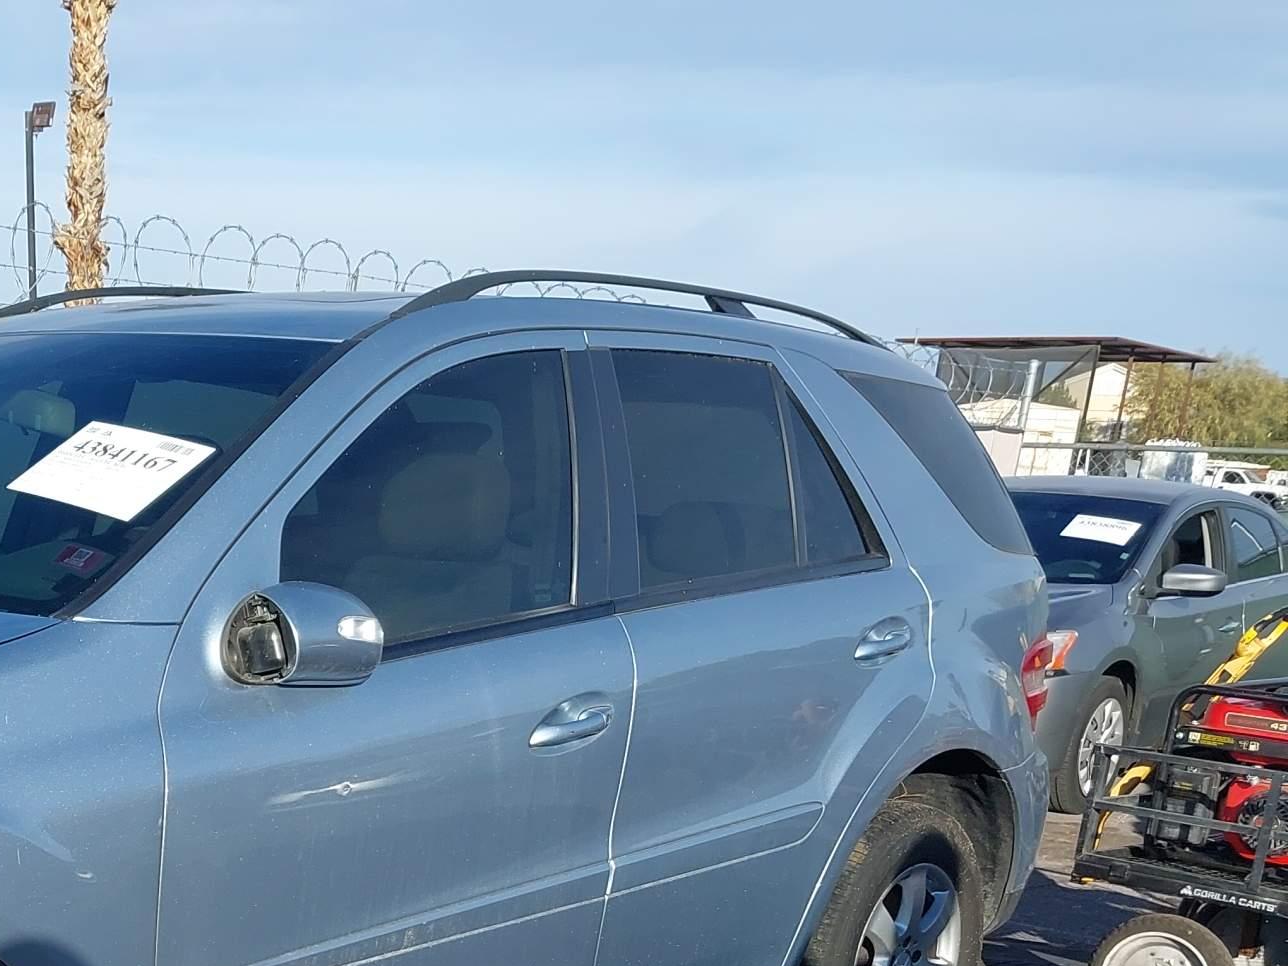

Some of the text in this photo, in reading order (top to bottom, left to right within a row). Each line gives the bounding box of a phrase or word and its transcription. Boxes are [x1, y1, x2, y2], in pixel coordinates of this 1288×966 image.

[73, 439, 177, 472] 43841167
[1193, 888, 1277, 913] GORILLA CARTS
